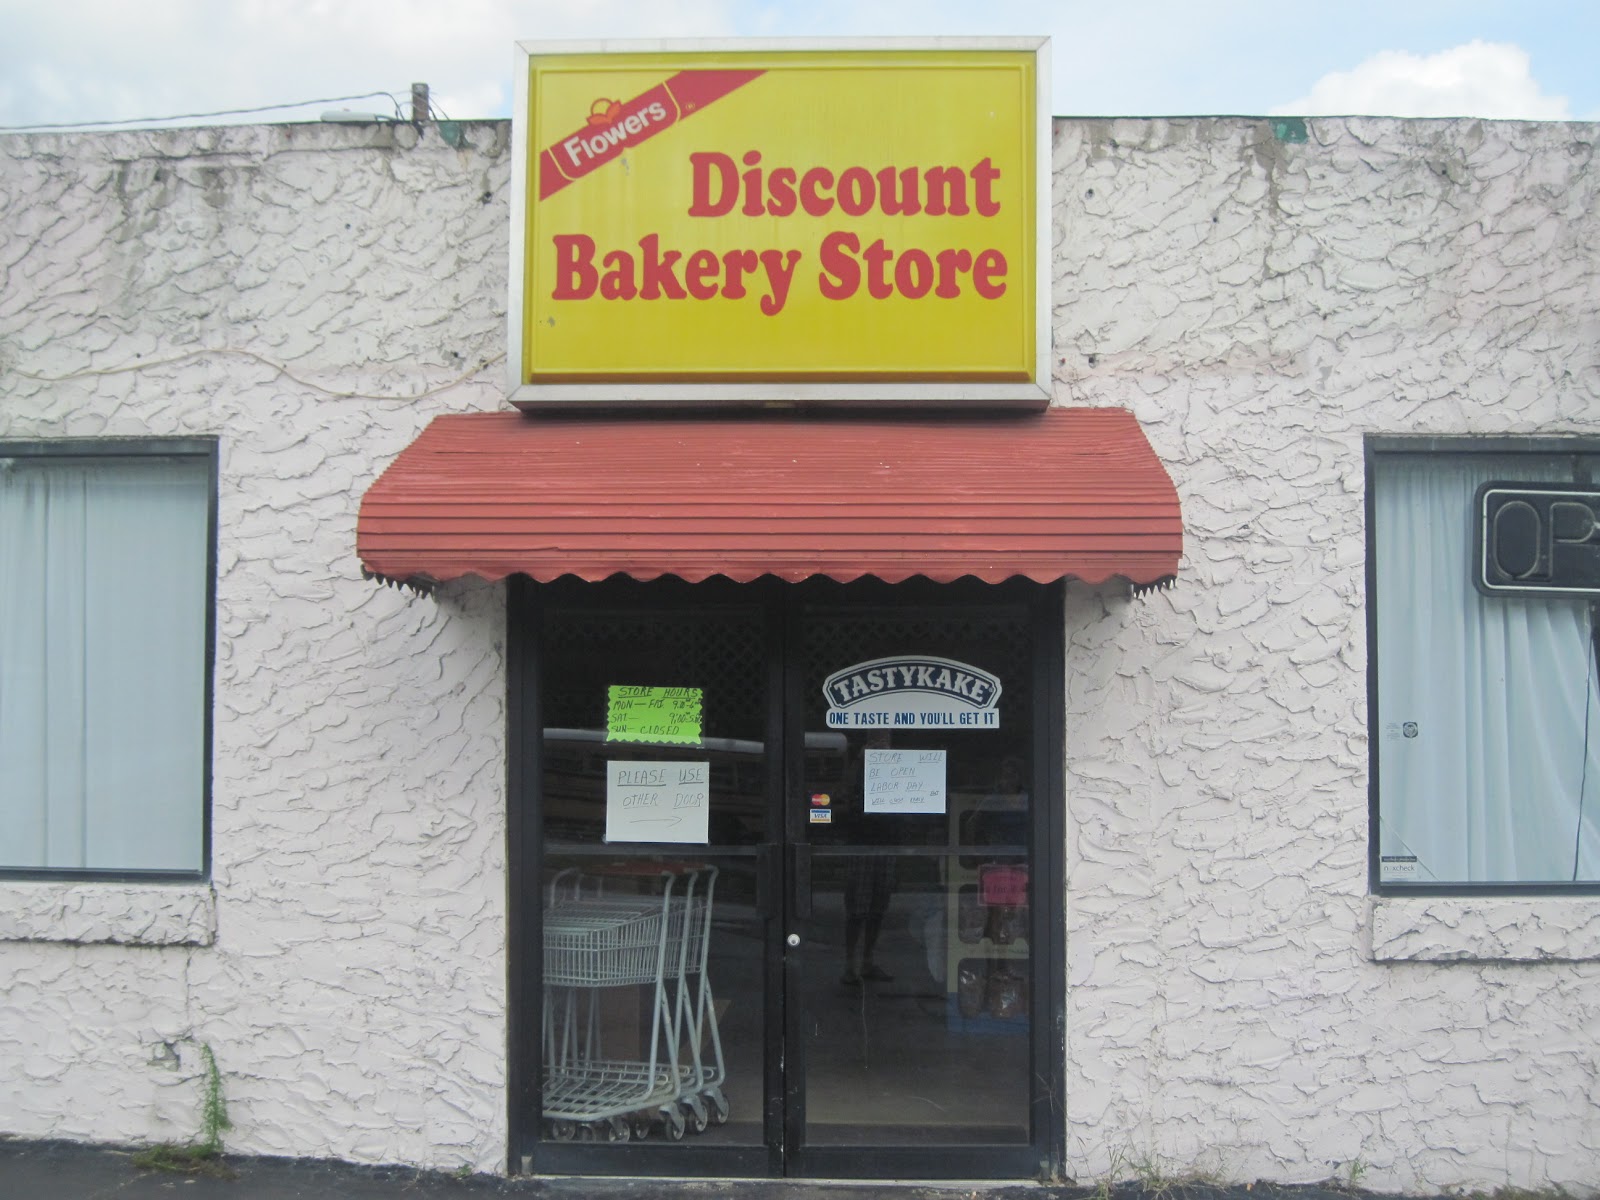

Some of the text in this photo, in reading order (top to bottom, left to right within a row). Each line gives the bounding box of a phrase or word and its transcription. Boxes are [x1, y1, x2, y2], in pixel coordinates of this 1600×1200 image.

[563, 102, 667, 167] Flowers
[688, 150, 1001, 218] Discount
[551, 231, 1008, 316] Bakery Store
[834, 666, 990, 703] TASTYKAKE
[618, 686, 698, 698] STORE HOURS
[613, 699, 633, 711] MON
[829, 712, 994, 725] ONE TASTE AND YOU'LL GET IT
[640, 726, 680, 735] CLOSED
[868, 752, 944, 763] STORE WILL
[617, 767, 702, 785] PLEASE USE
[869, 767, 916, 777] BE OPEN
[870, 782, 899, 792] LABOR
[906, 782, 923, 791] DAY
[622, 793, 659, 807] OTHER
